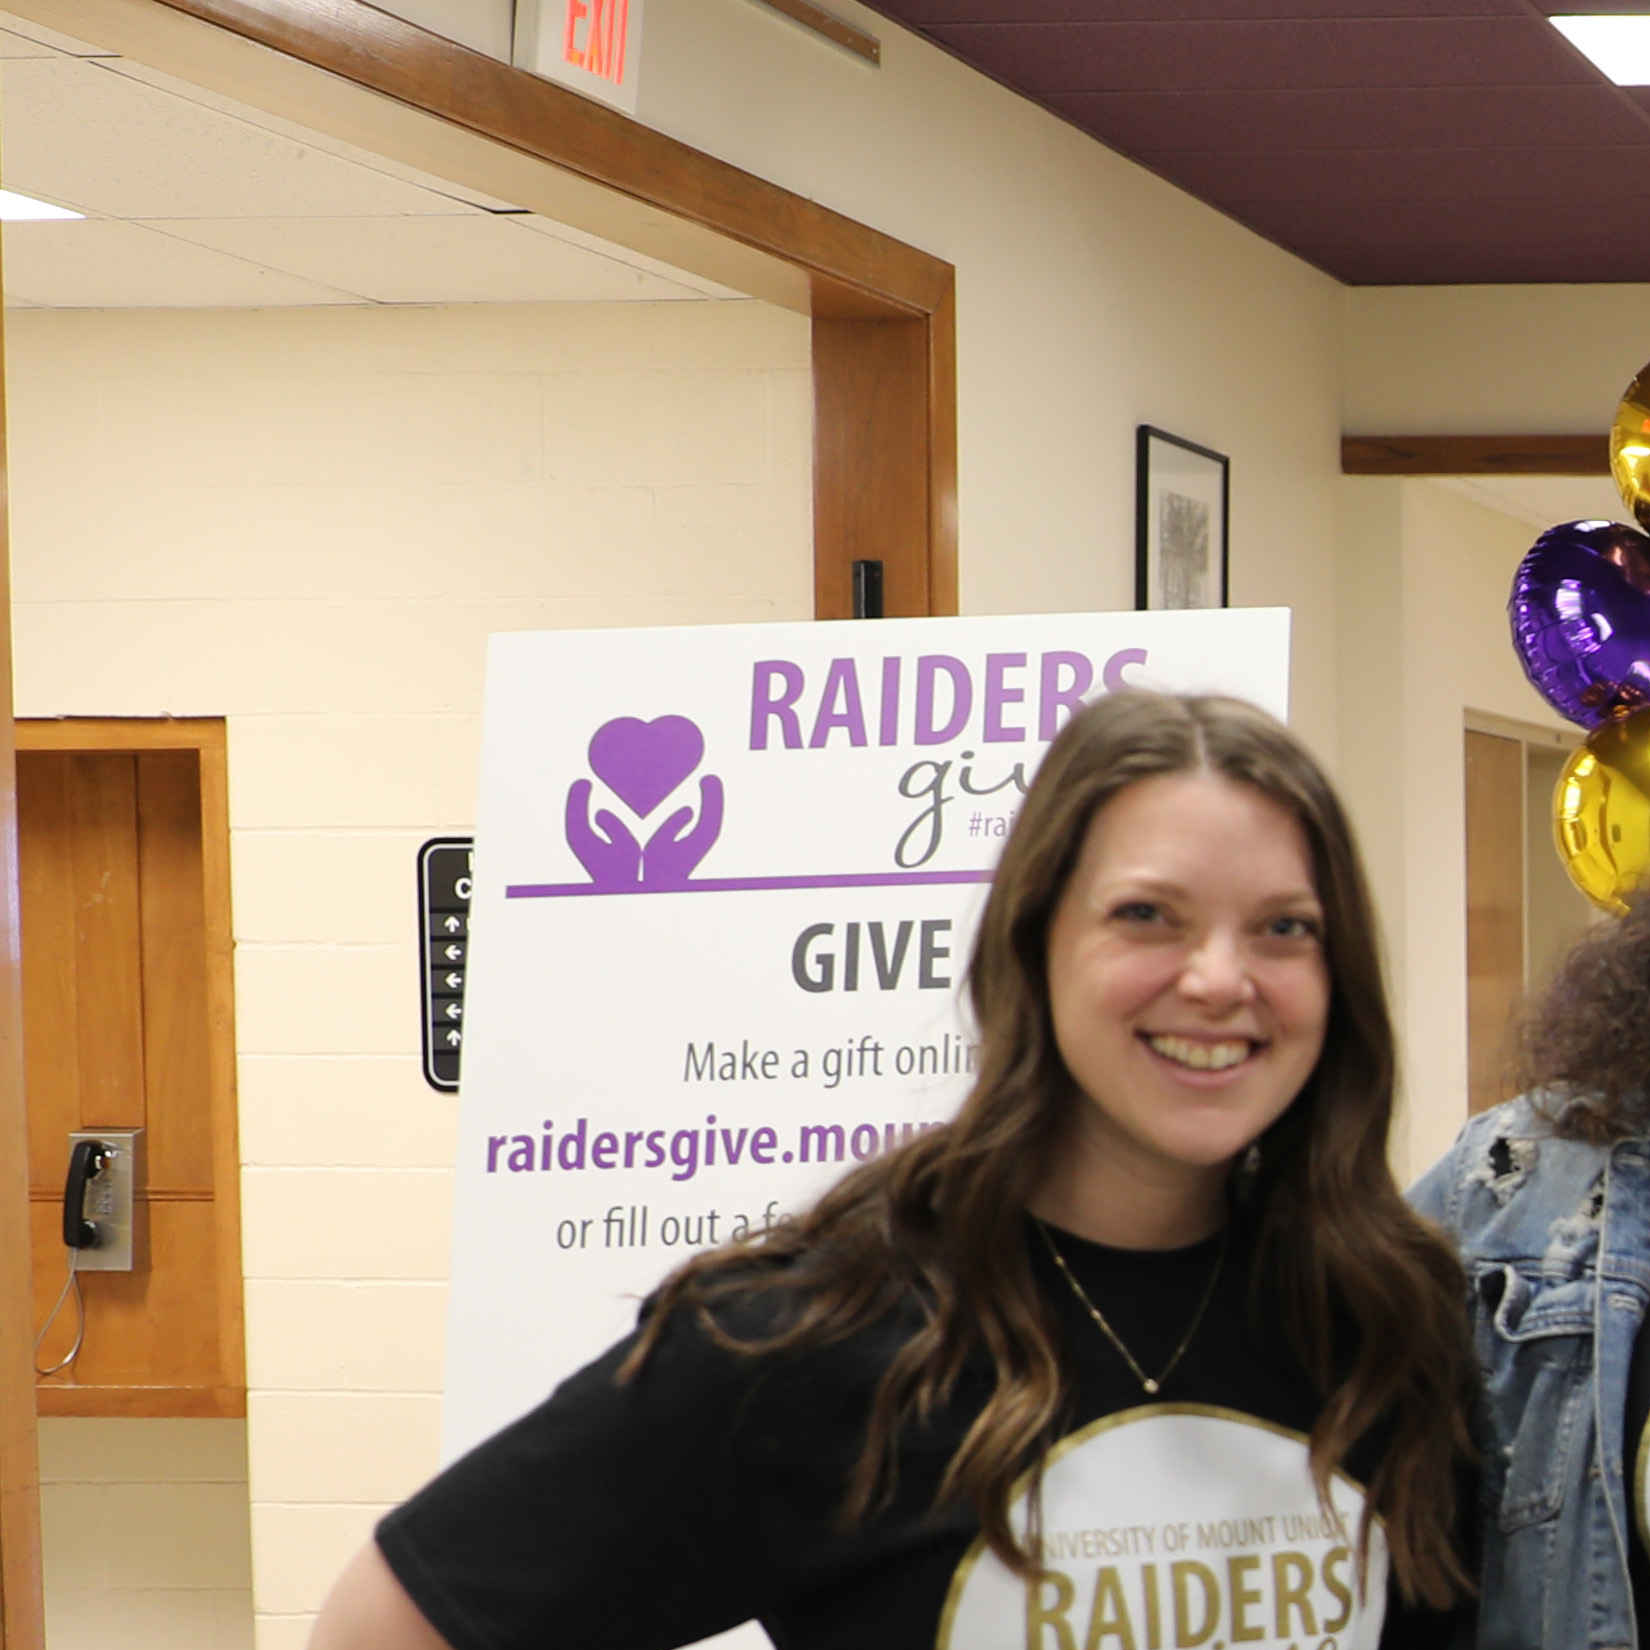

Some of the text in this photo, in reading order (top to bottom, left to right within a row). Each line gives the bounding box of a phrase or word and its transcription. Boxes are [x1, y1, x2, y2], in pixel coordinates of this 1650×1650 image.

[791, 918, 952, 993] GIVE
[684, 1040, 779, 1082] Make
[791, 1049, 809, 1079] a
[822, 1036, 884, 1089] gift
[486, 1114, 948, 1182] raidersgive.mou
[556, 1218, 593, 1249] or
[603, 1205, 648, 1248] fill
[661, 1209, 719, 1246] out
[1044, 1525, 1156, 1560] NIVERSITY
[1163, 1523, 1191, 1552] OF
[1199, 1516, 1276, 1549] MOUNT
